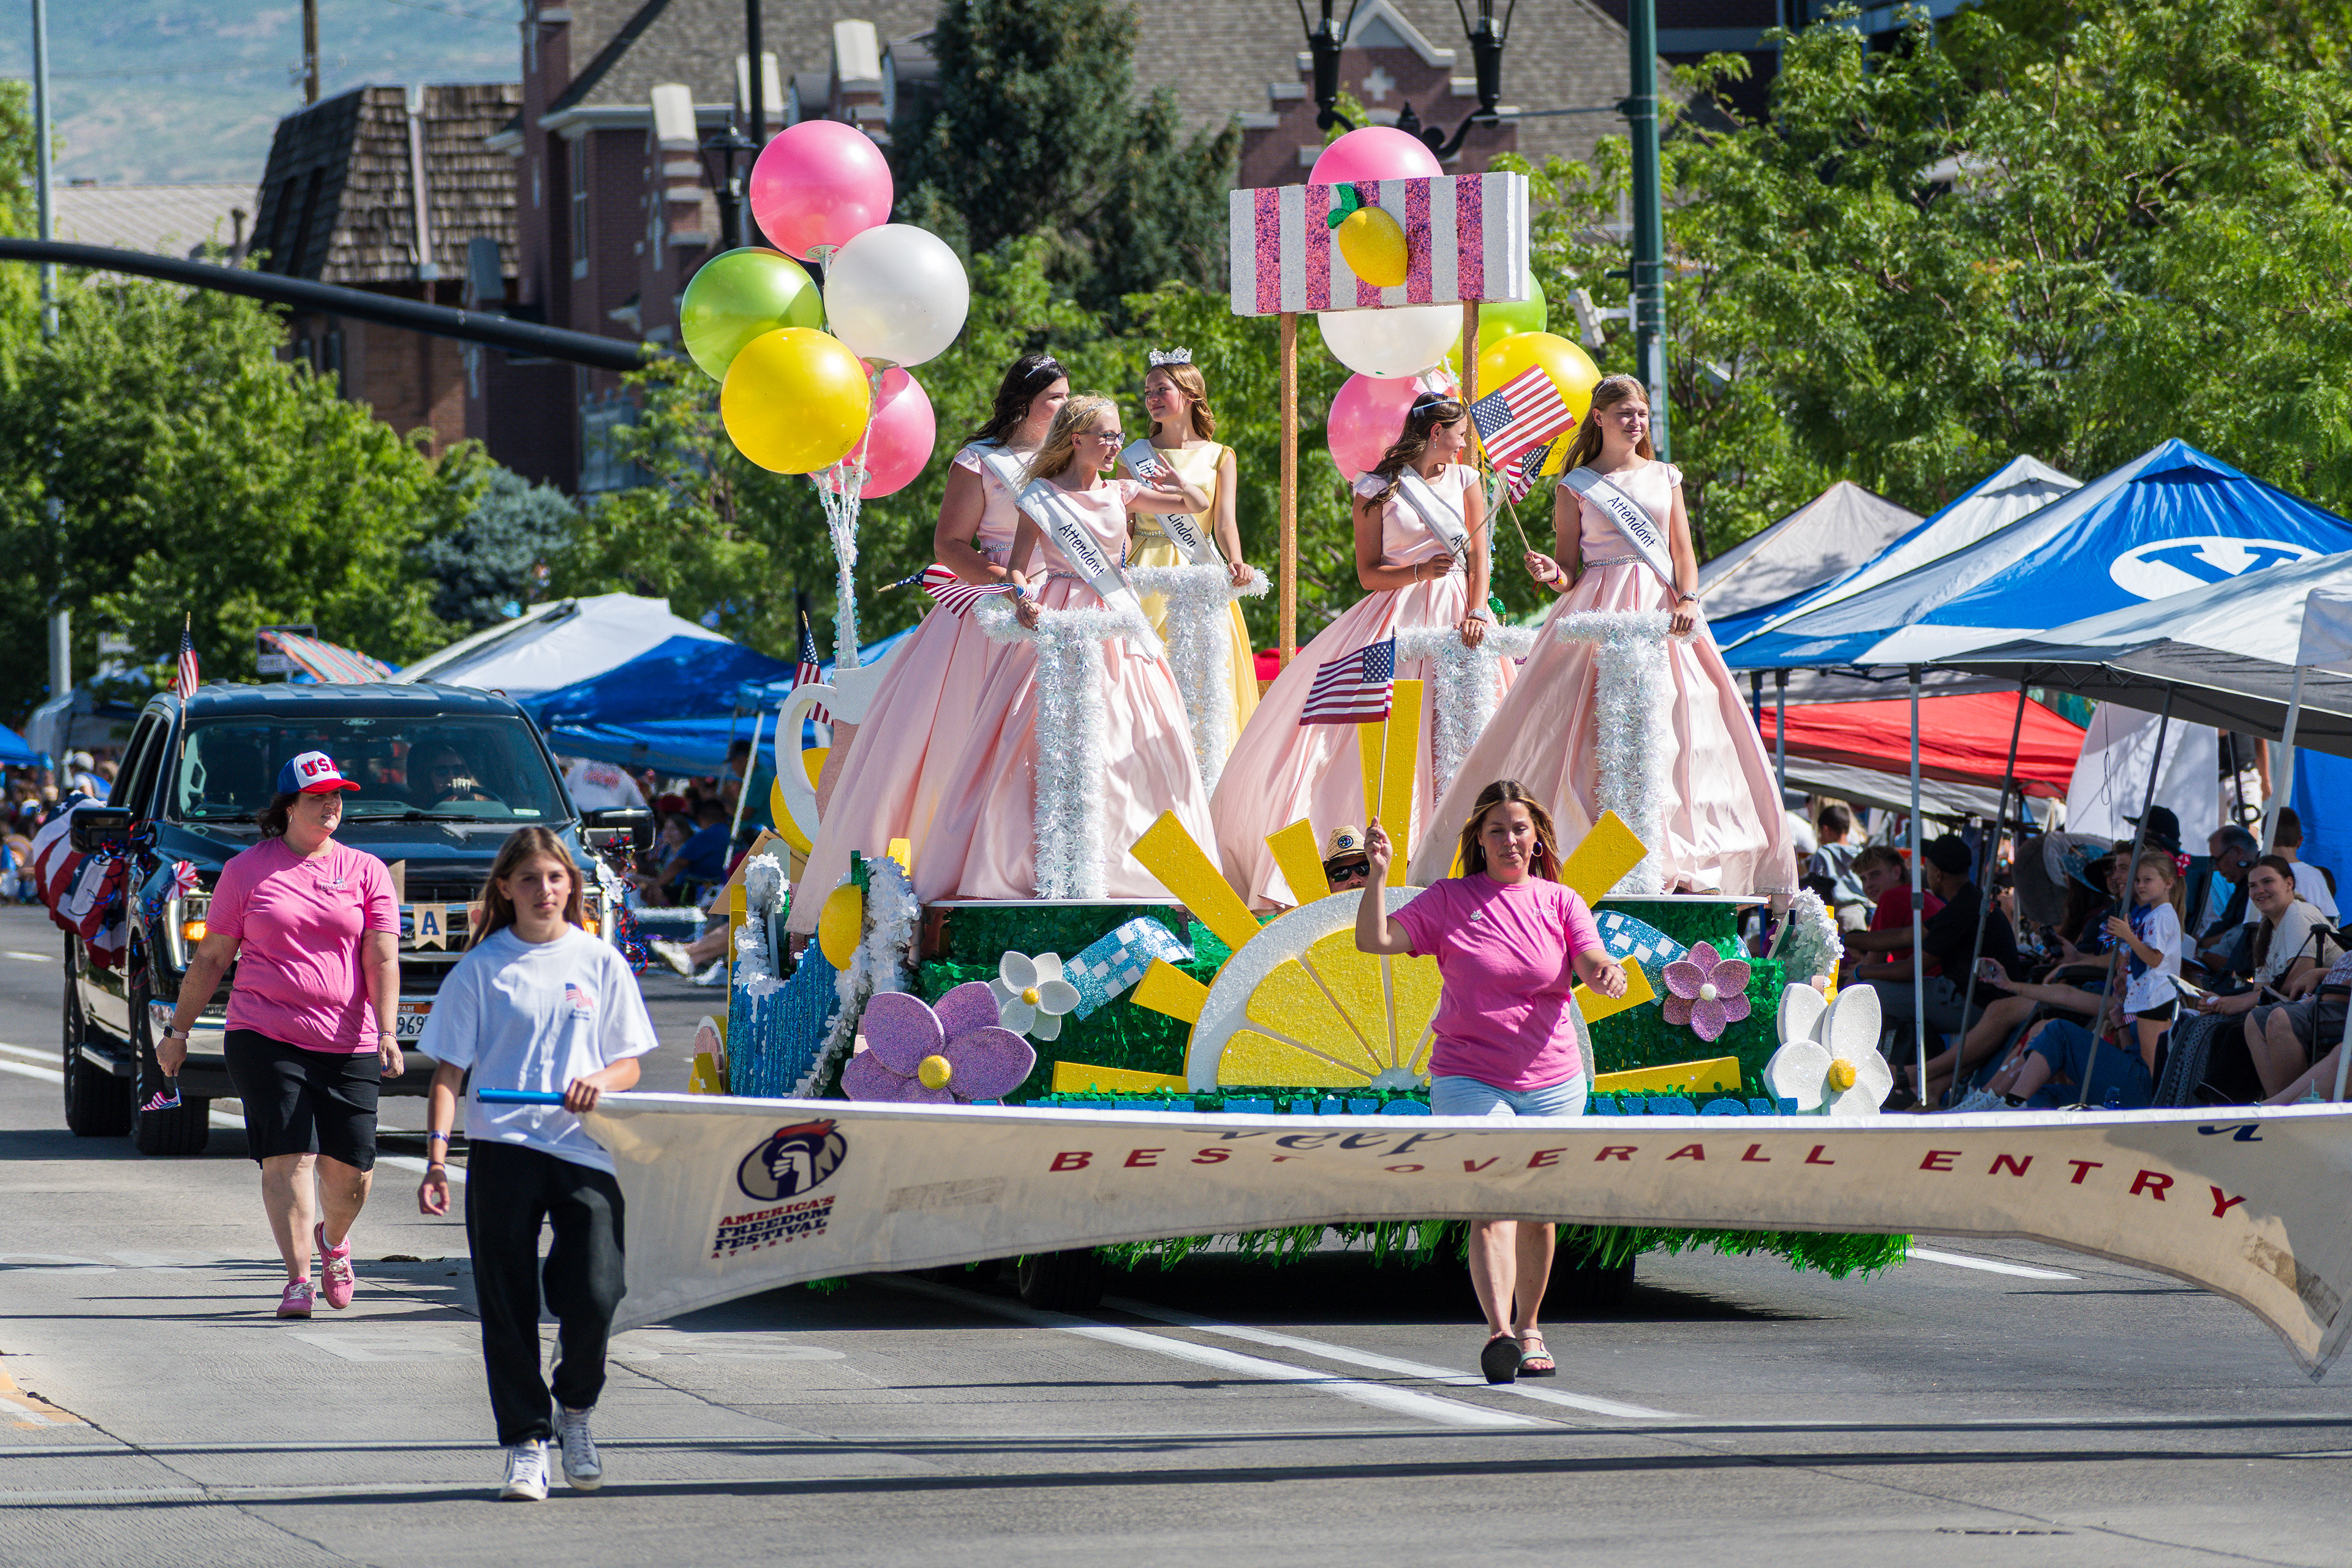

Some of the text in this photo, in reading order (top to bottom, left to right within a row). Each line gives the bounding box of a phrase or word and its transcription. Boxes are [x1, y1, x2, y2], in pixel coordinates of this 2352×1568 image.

[1167, 514, 1196, 548] Lindon
[1607, 496, 1656, 548] Attendant
[1058, 523, 1104, 577] Attendant
[398, 1016, 429, 1035] 969
[1383, 1143, 1836, 1174] OVERALL
[1919, 1150, 2247, 1219] ENTRY
[716, 1206, 833, 1238] FREEDOM
[718, 1195, 836, 1226] AMERICA'S
[711, 1229, 826, 1259] AT PROVO
[713, 1218, 828, 1251] FESTIVAL
